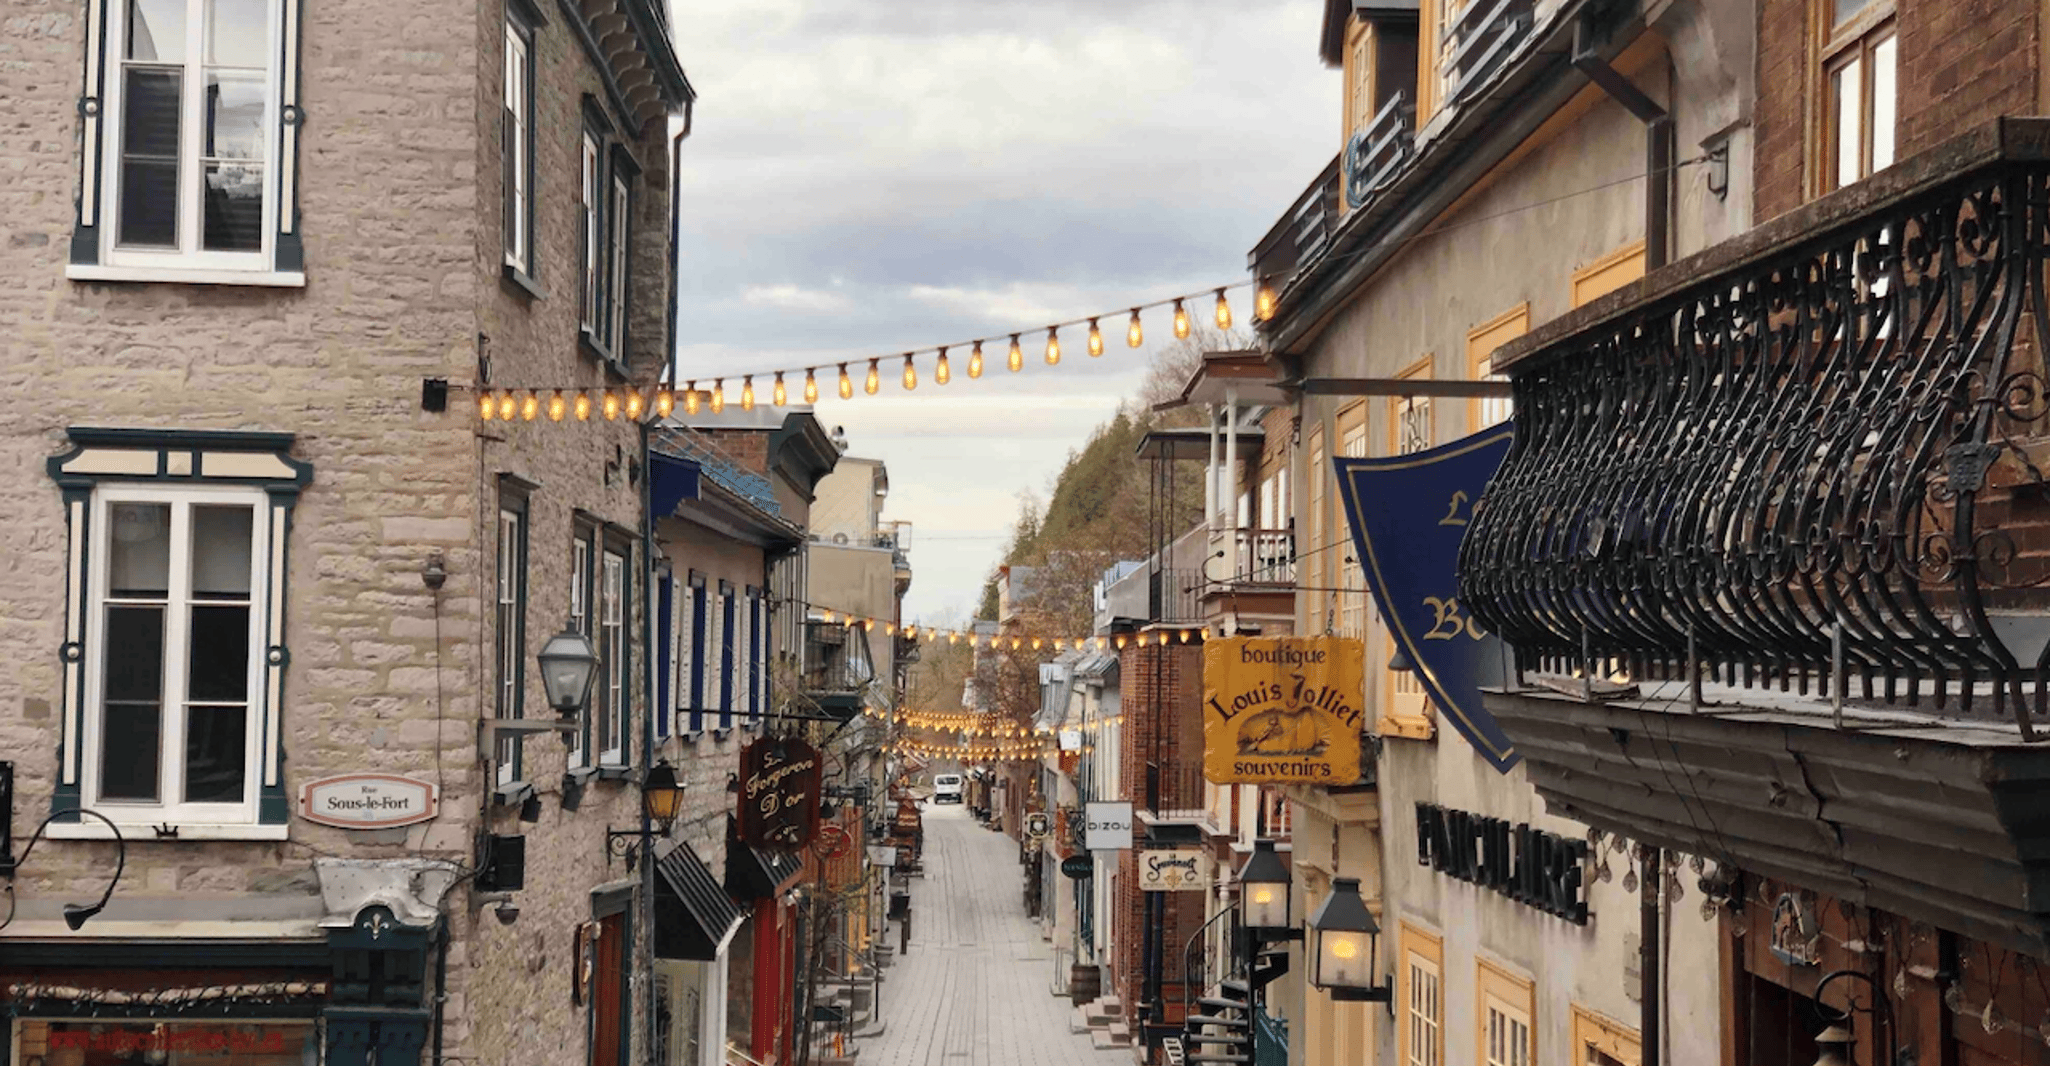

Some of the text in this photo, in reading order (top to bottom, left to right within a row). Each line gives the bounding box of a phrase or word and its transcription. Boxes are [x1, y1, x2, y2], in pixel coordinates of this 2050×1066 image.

[1241, 642, 1326, 669] boutique
[1206, 674, 1361, 728] Louis Jolliet
[1234, 757, 1331, 780] souvenirs
[361, 786, 377, 794] Rue
[327, 796, 409, 810] Sous-le-Fort
